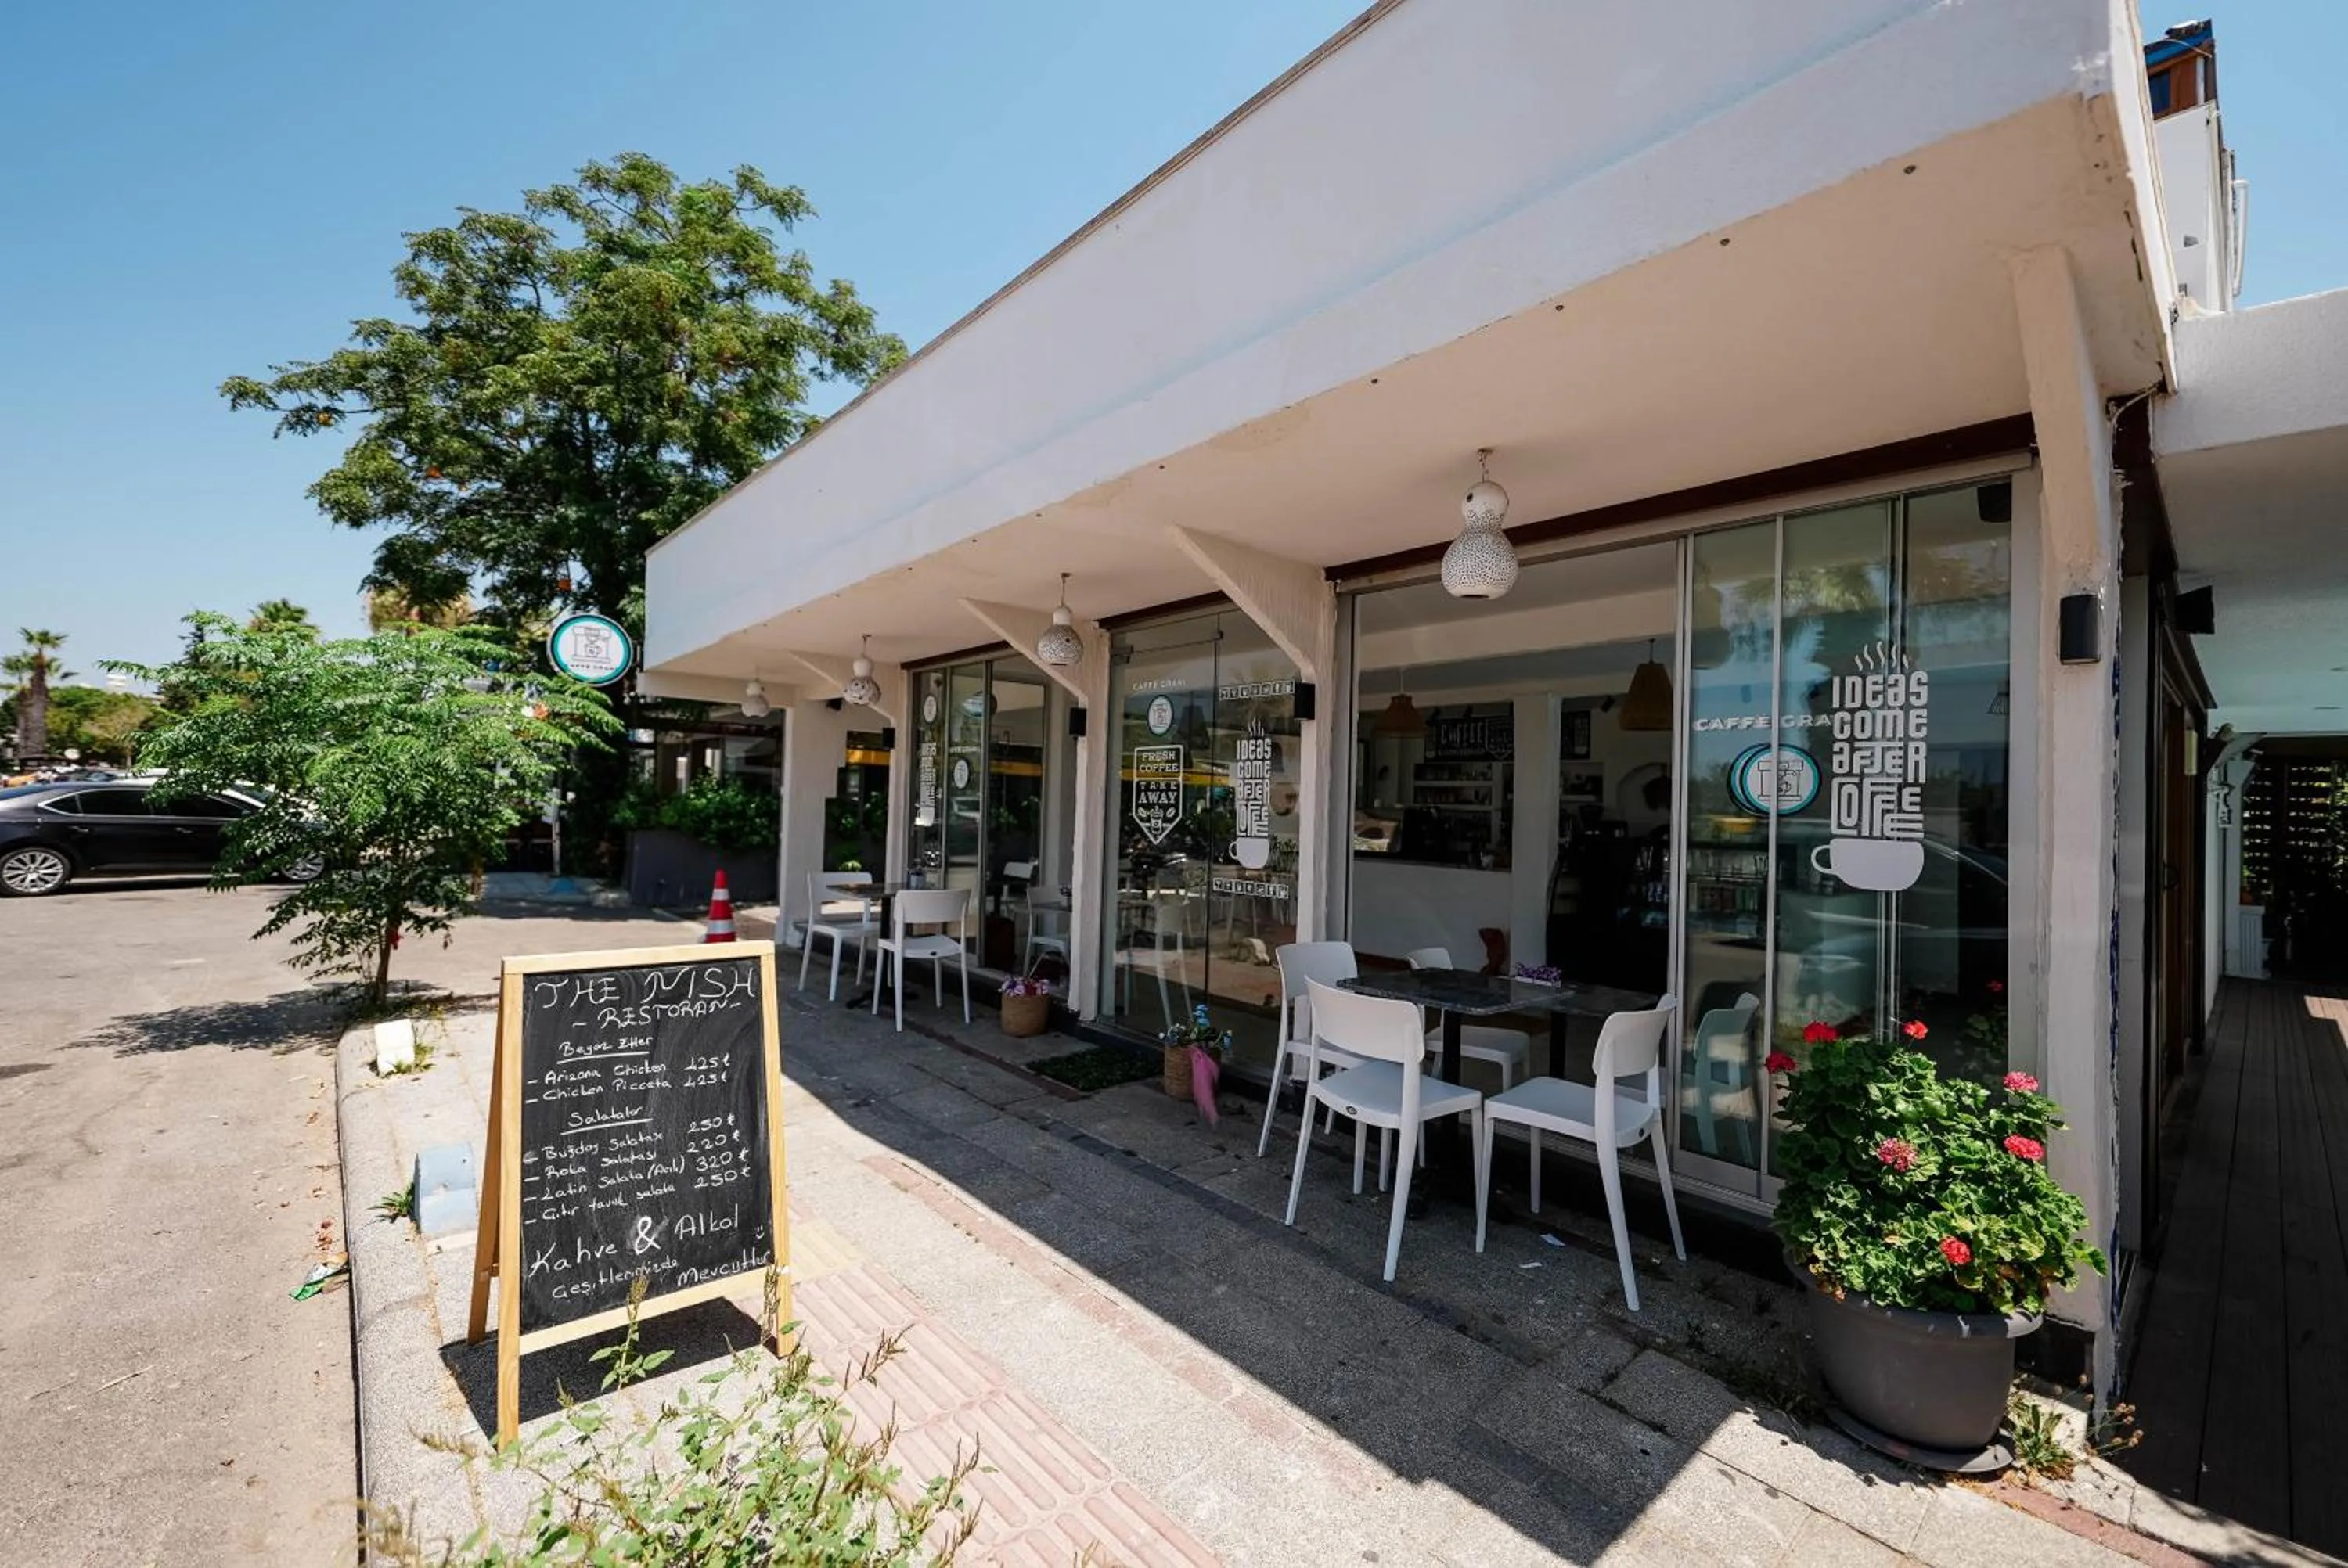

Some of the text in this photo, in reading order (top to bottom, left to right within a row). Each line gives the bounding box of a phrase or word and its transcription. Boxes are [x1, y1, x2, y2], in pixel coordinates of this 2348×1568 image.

[1781, 714, 1835, 728] GRA
[1142, 751, 1176, 761] FRESH
[1140, 763, 1179, 773] COFFEE
[1138, 791, 1177, 804] AWAY
[535, 967, 755, 1008] THE NISH
[544, 1070, 601, 1086] Arizona
[613, 1059, 667, 1077] Chicken
[542, 1083, 603, 1101] Chicken
[542, 1183, 587, 1201] Latin
[529, 1203, 739, 1278] Kahve & Alkol
